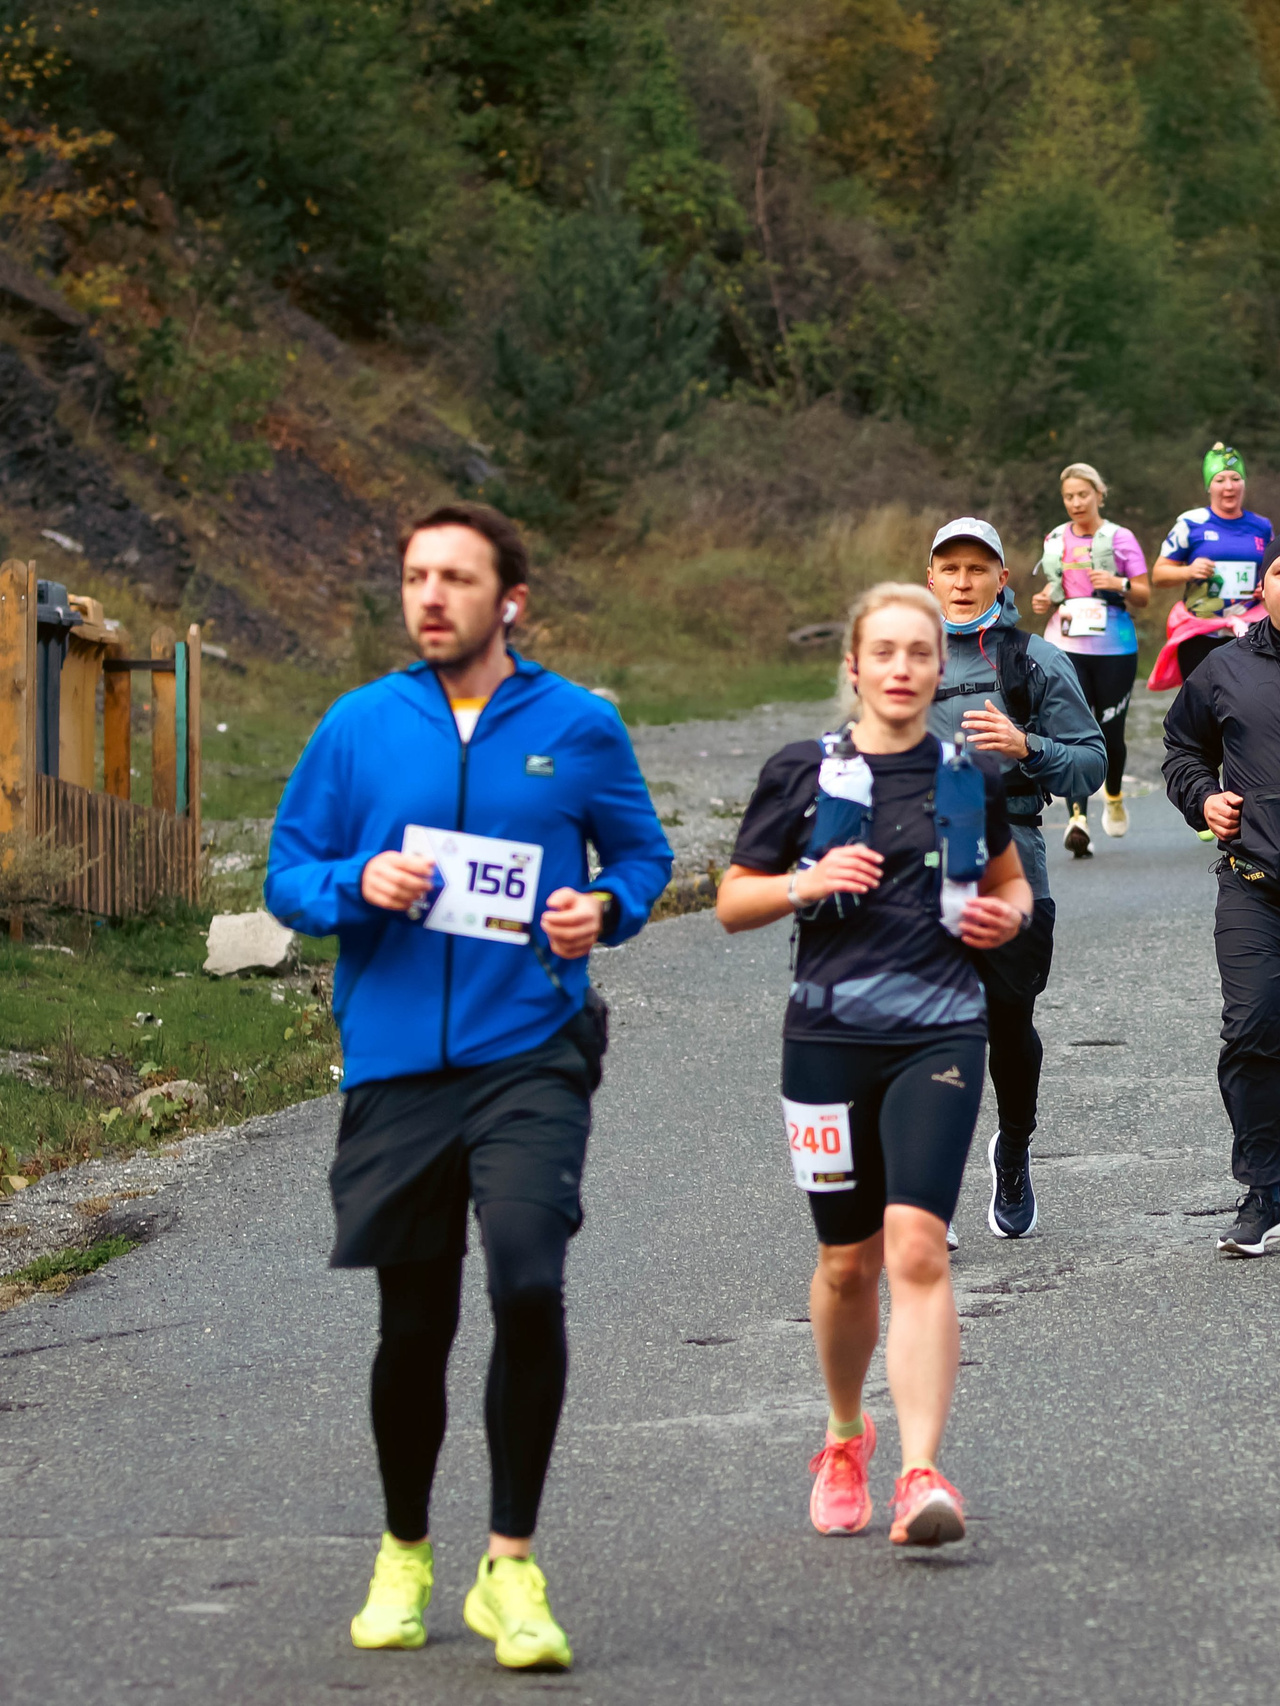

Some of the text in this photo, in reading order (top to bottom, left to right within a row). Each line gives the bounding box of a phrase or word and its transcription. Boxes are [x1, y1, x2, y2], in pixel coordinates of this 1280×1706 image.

[1236, 572, 1249, 583] 14
[467, 861, 526, 899] 156
[790, 1122, 841, 1155] 240
